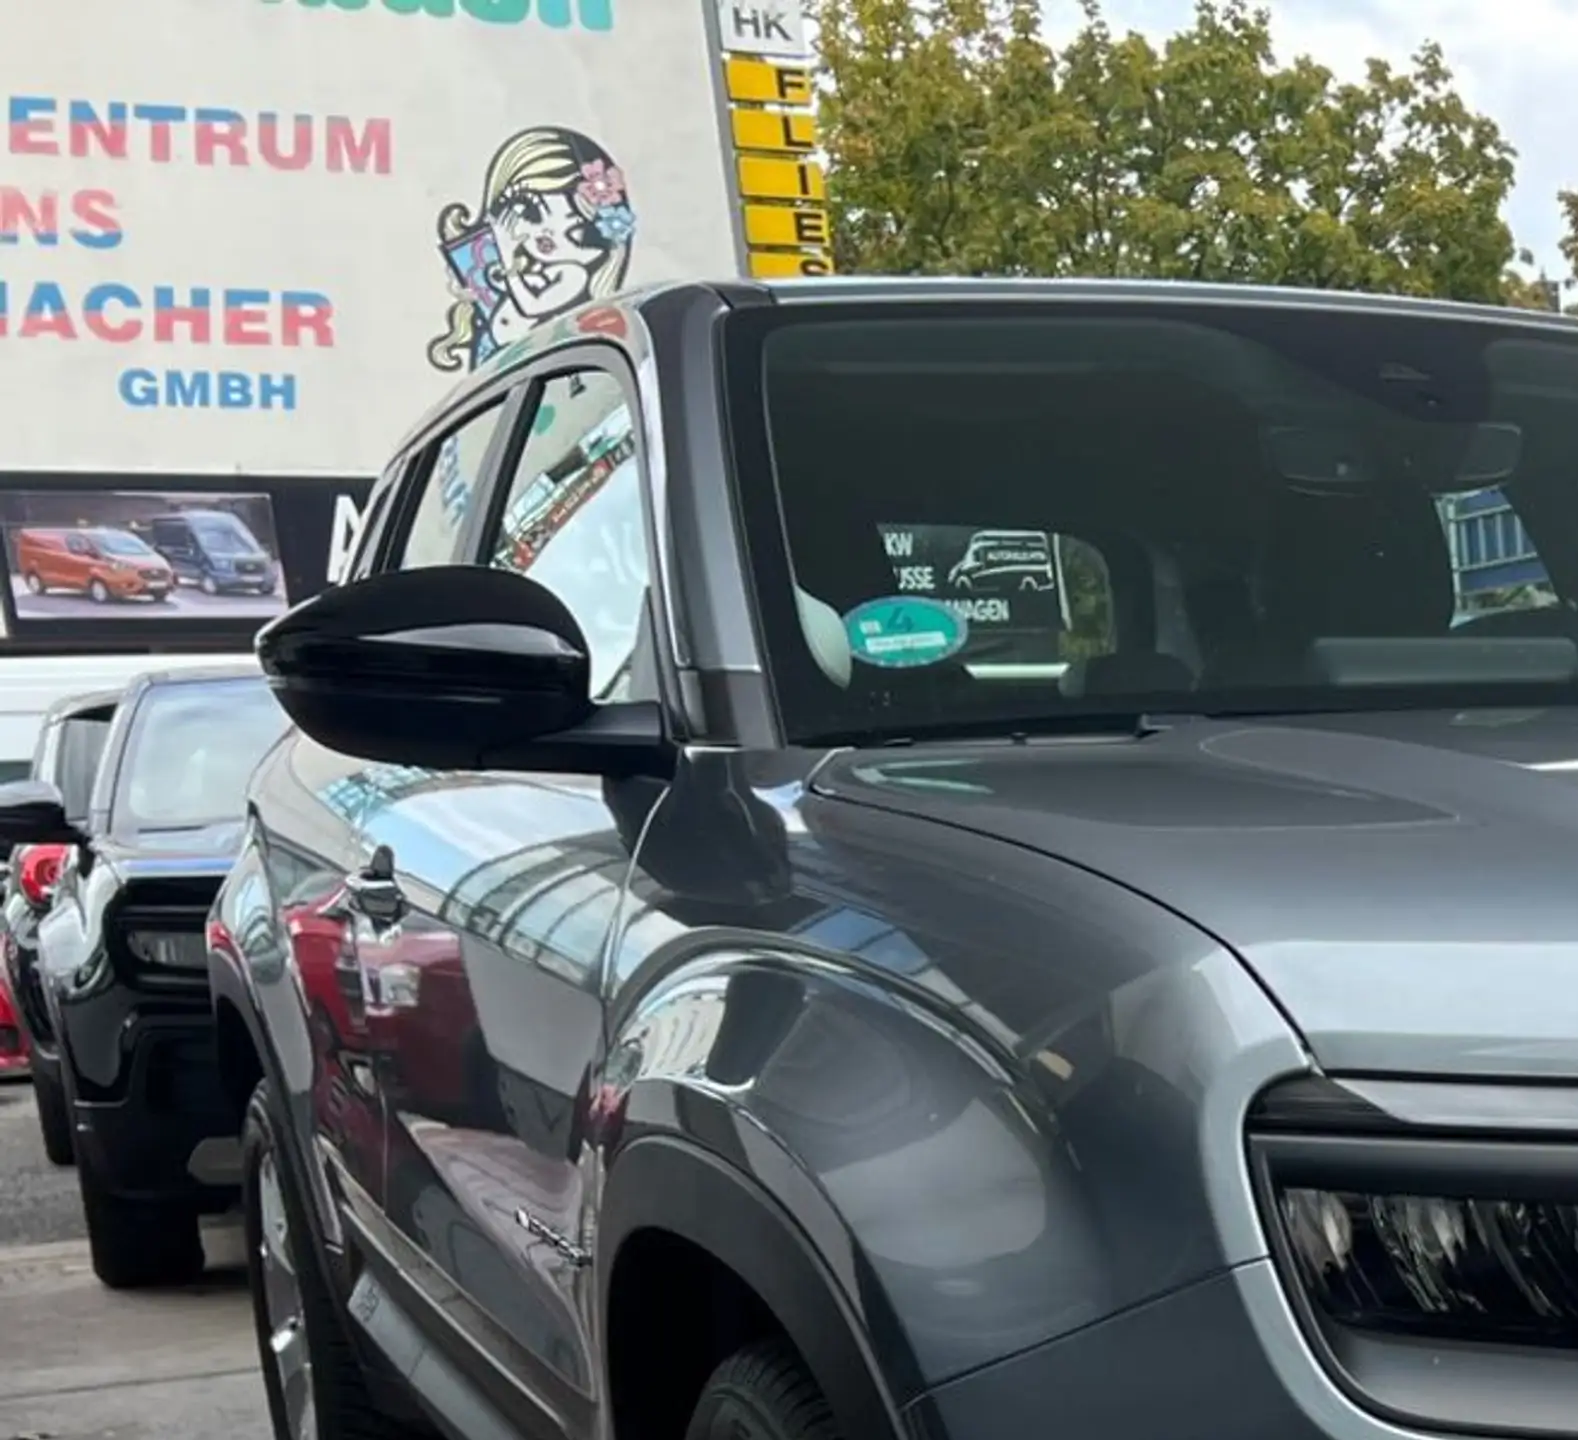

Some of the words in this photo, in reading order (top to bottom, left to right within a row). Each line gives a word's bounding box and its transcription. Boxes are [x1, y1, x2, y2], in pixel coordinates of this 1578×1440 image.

[733, 6, 793, 41] HK
[8, 96, 393, 175] ENTRUM
[118, 367, 297, 410] GMBH
